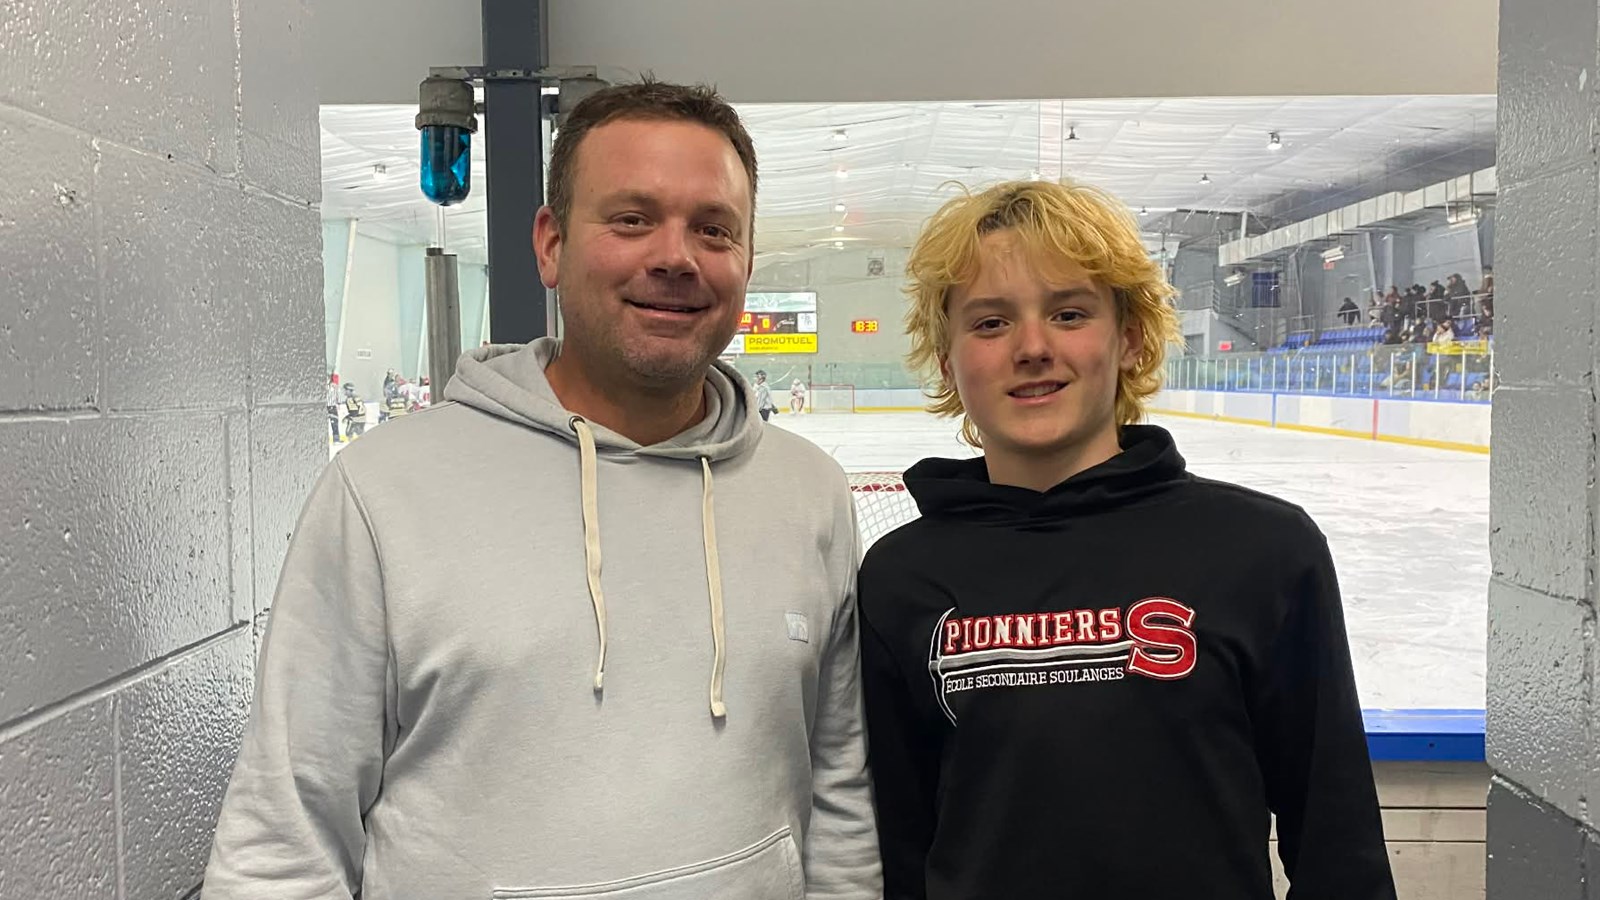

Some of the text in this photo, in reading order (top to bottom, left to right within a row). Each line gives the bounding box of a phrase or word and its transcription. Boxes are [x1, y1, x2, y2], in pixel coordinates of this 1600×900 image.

[945, 608, 1122, 654] PIONNIERS
[1126, 597, 1197, 680] S
[975, 671, 1047, 688] SECONDAIRE
[1049, 667, 1125, 683] SOULANGES
